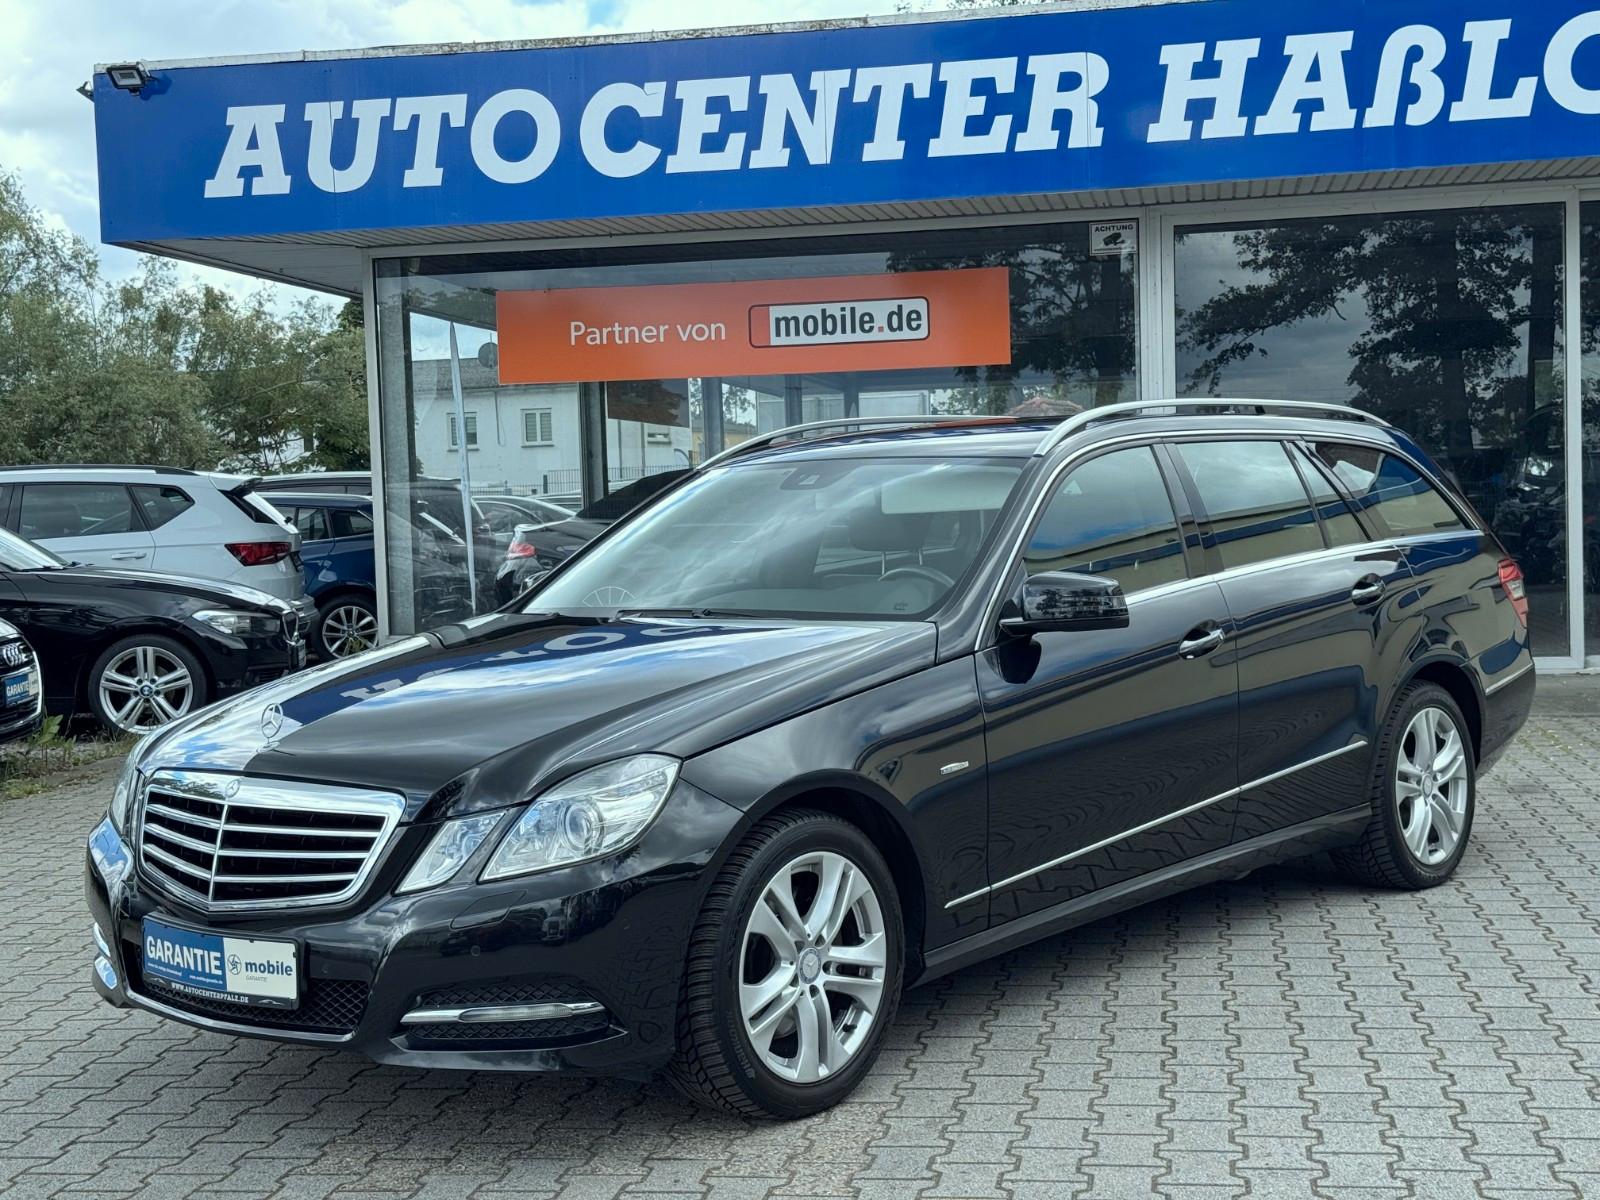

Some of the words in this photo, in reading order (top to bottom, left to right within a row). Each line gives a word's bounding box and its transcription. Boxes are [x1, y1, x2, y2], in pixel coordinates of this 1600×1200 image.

[1095, 224, 1134, 232] ACHTUNG
[569, 320, 669, 347] Partner
[676, 320, 727, 342] von
[774, 302, 923, 339] mobile.de
[146, 935, 223, 975] GARANTIE
[244, 959, 293, 977] mobile
